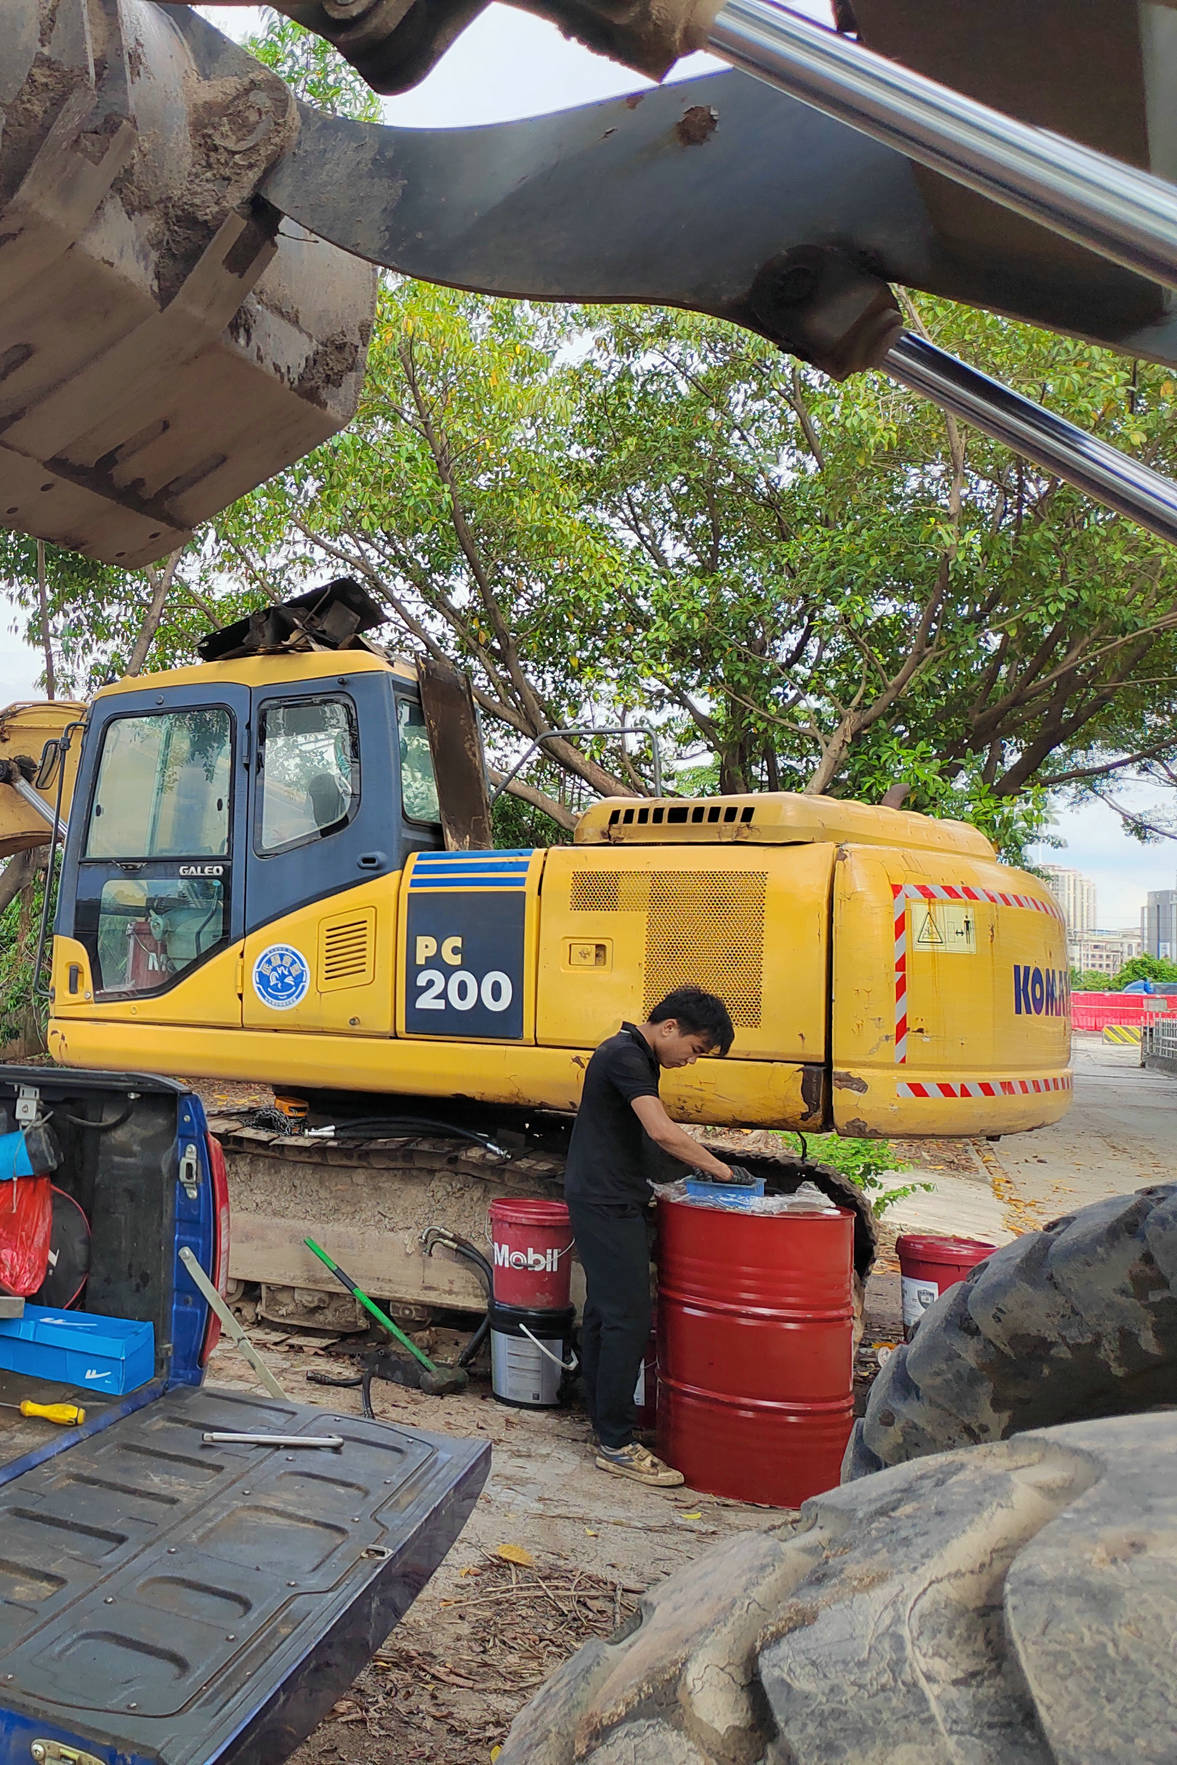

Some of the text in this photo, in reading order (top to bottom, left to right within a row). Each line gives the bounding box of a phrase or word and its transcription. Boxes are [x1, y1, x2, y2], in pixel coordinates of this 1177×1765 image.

[179, 865, 224, 876] GALEO
[415, 935, 463, 966] PC
[415, 969, 513, 1012] 200
[493, 1241, 559, 1272] Mobil
